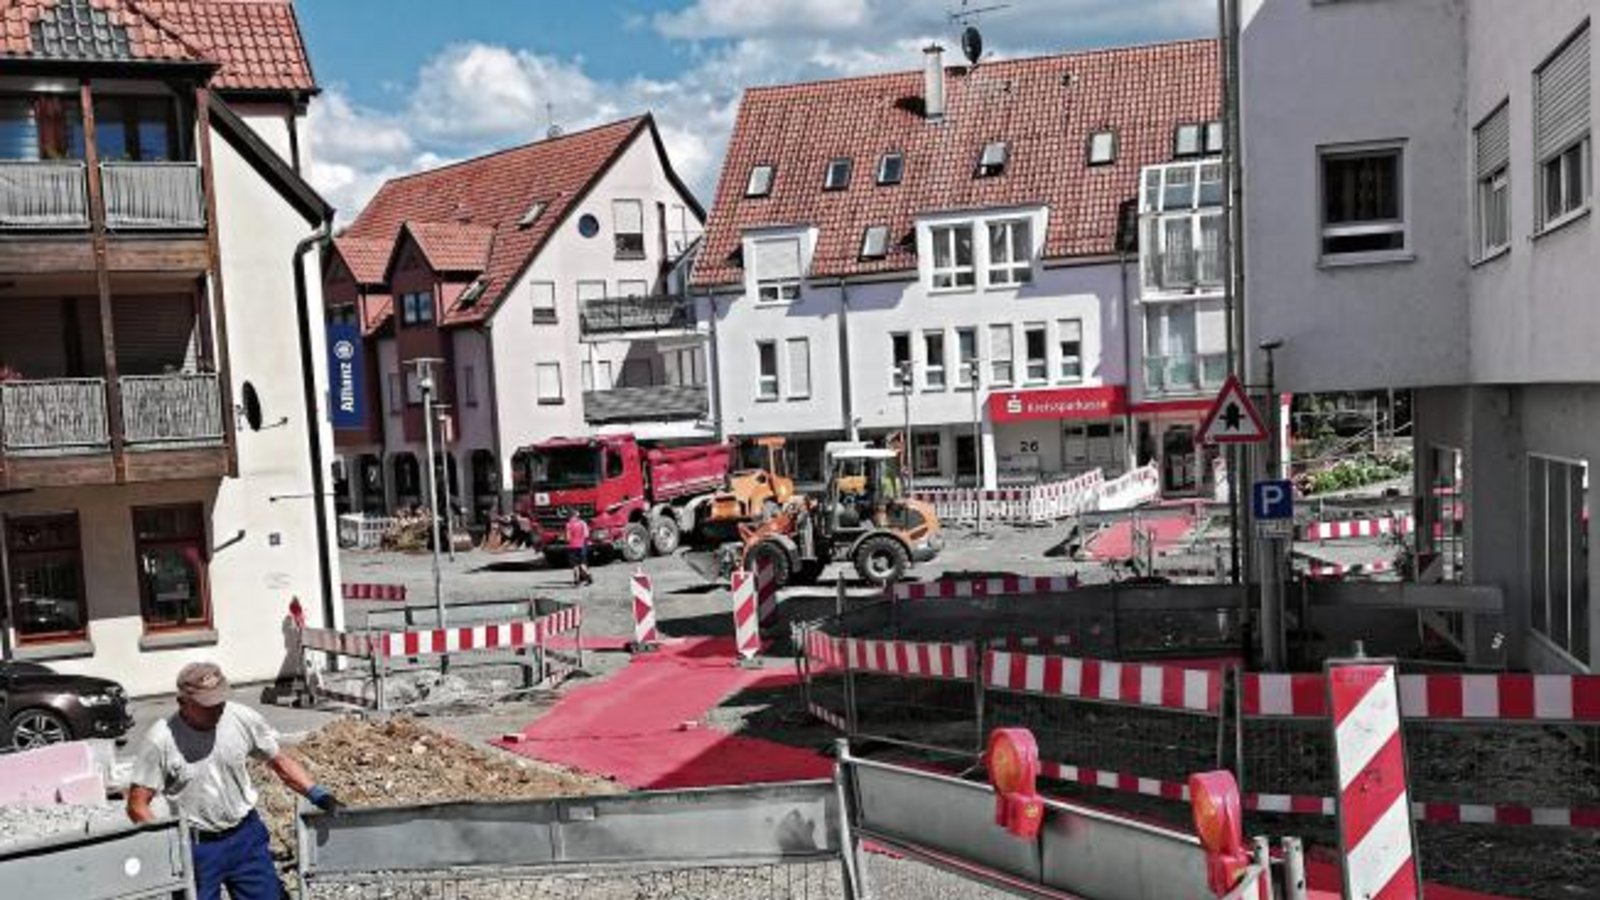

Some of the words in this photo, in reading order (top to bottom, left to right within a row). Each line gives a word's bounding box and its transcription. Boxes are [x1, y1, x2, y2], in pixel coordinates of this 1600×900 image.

[340, 362, 354, 413] Allianz
[1020, 441, 1040, 453] 26
[1261, 485, 1284, 515] P
